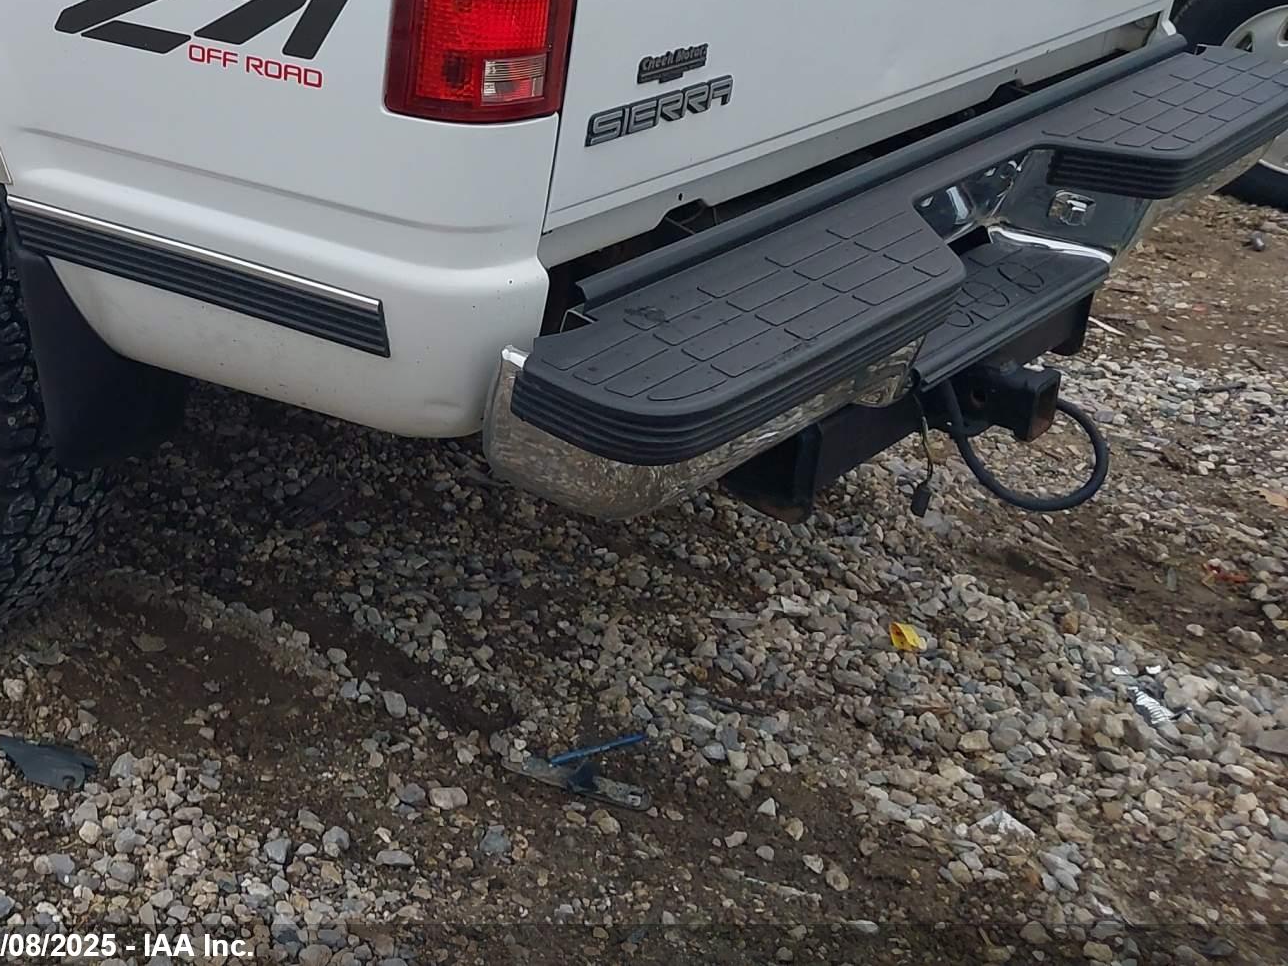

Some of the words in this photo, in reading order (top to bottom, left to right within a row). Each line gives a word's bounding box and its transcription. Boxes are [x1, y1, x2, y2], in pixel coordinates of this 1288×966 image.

[188, 44, 239, 68] OFF
[245, 56, 323, 89] ROAD
[584, 75, 733, 147] SIERRA
